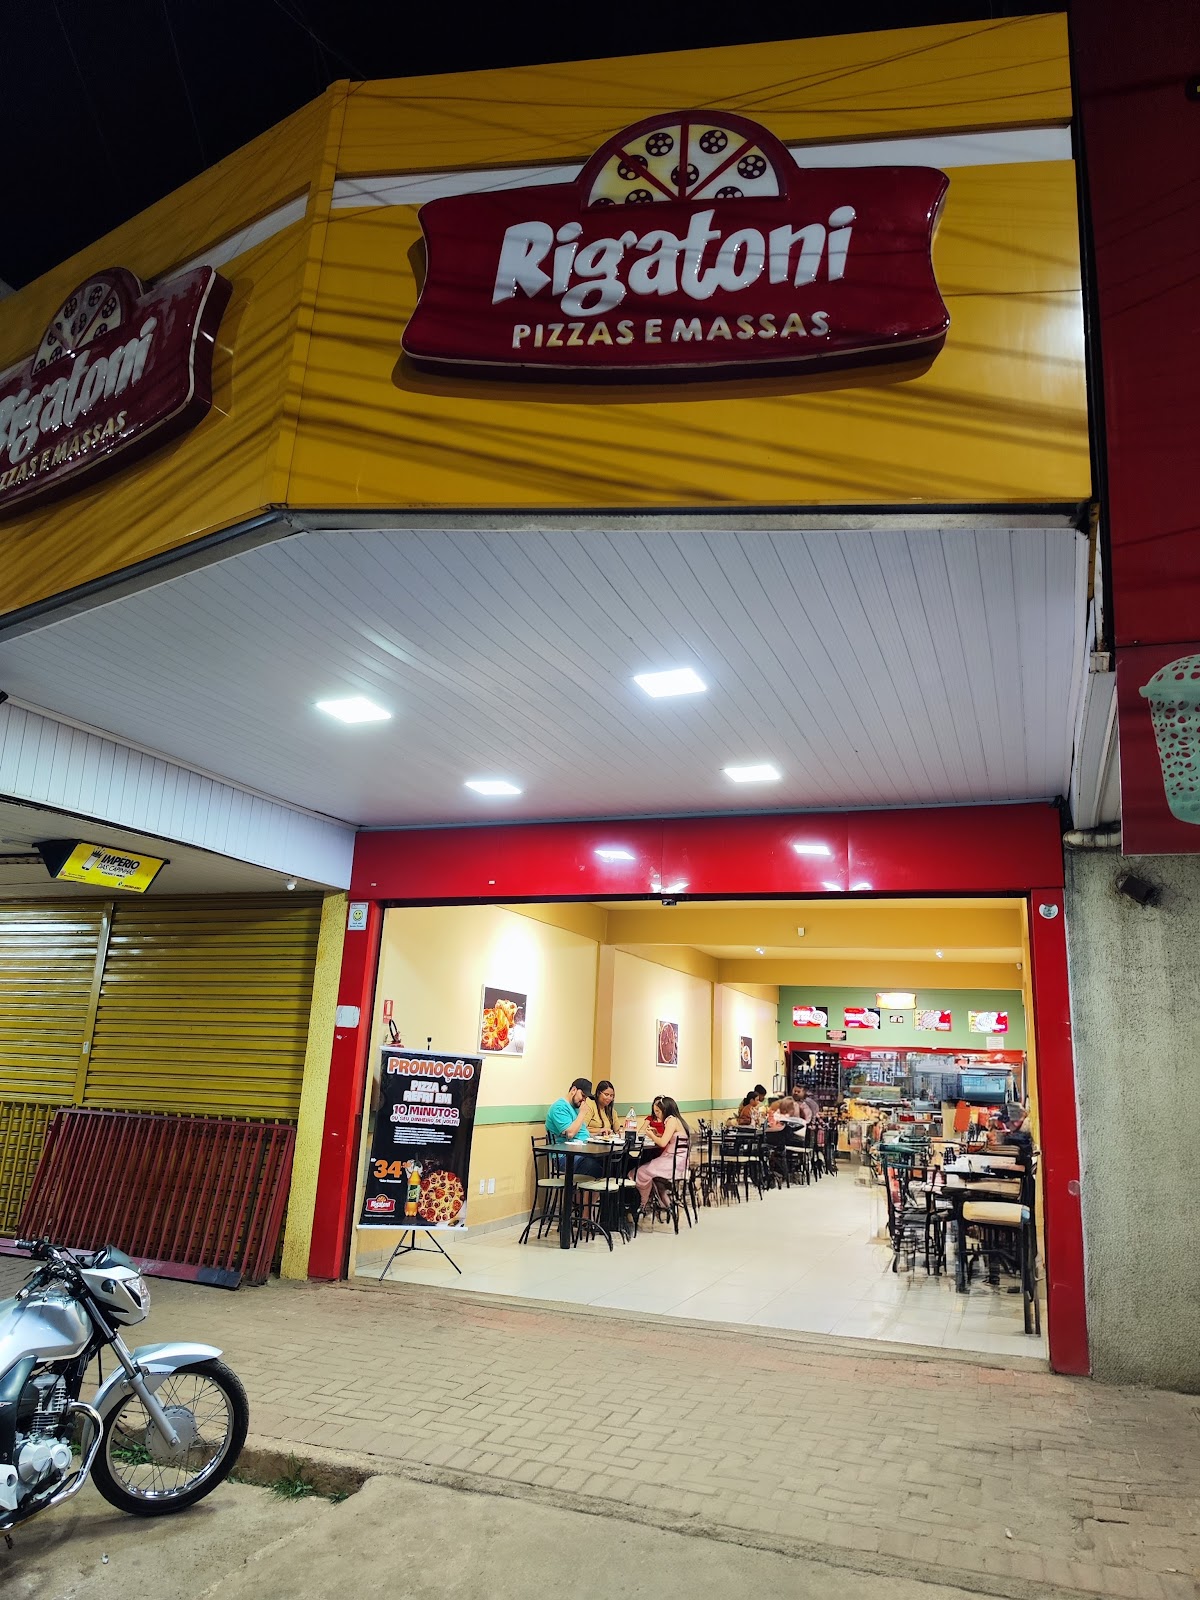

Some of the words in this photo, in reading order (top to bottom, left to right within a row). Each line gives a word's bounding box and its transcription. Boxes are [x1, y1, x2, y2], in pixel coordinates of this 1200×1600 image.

[491, 205, 857, 317] Rigatoni
[512, 320, 634, 349] PIZZAS
[644, 318, 663, 343] E
[671, 311, 829, 342] MASSAS
[0, 456, 39, 491] ZZAS
[40, 449, 52, 472] E
[51, 411, 128, 467] MASSAS
[101, 854, 140, 870] IMPÉRIO
[387, 1057, 474, 1082] PROMOÇÃO
[410, 1080, 439, 1092] PIZZA
[393, 1104, 407, 1115] 10
[409, 1105, 459, 1118] MINUTOS
